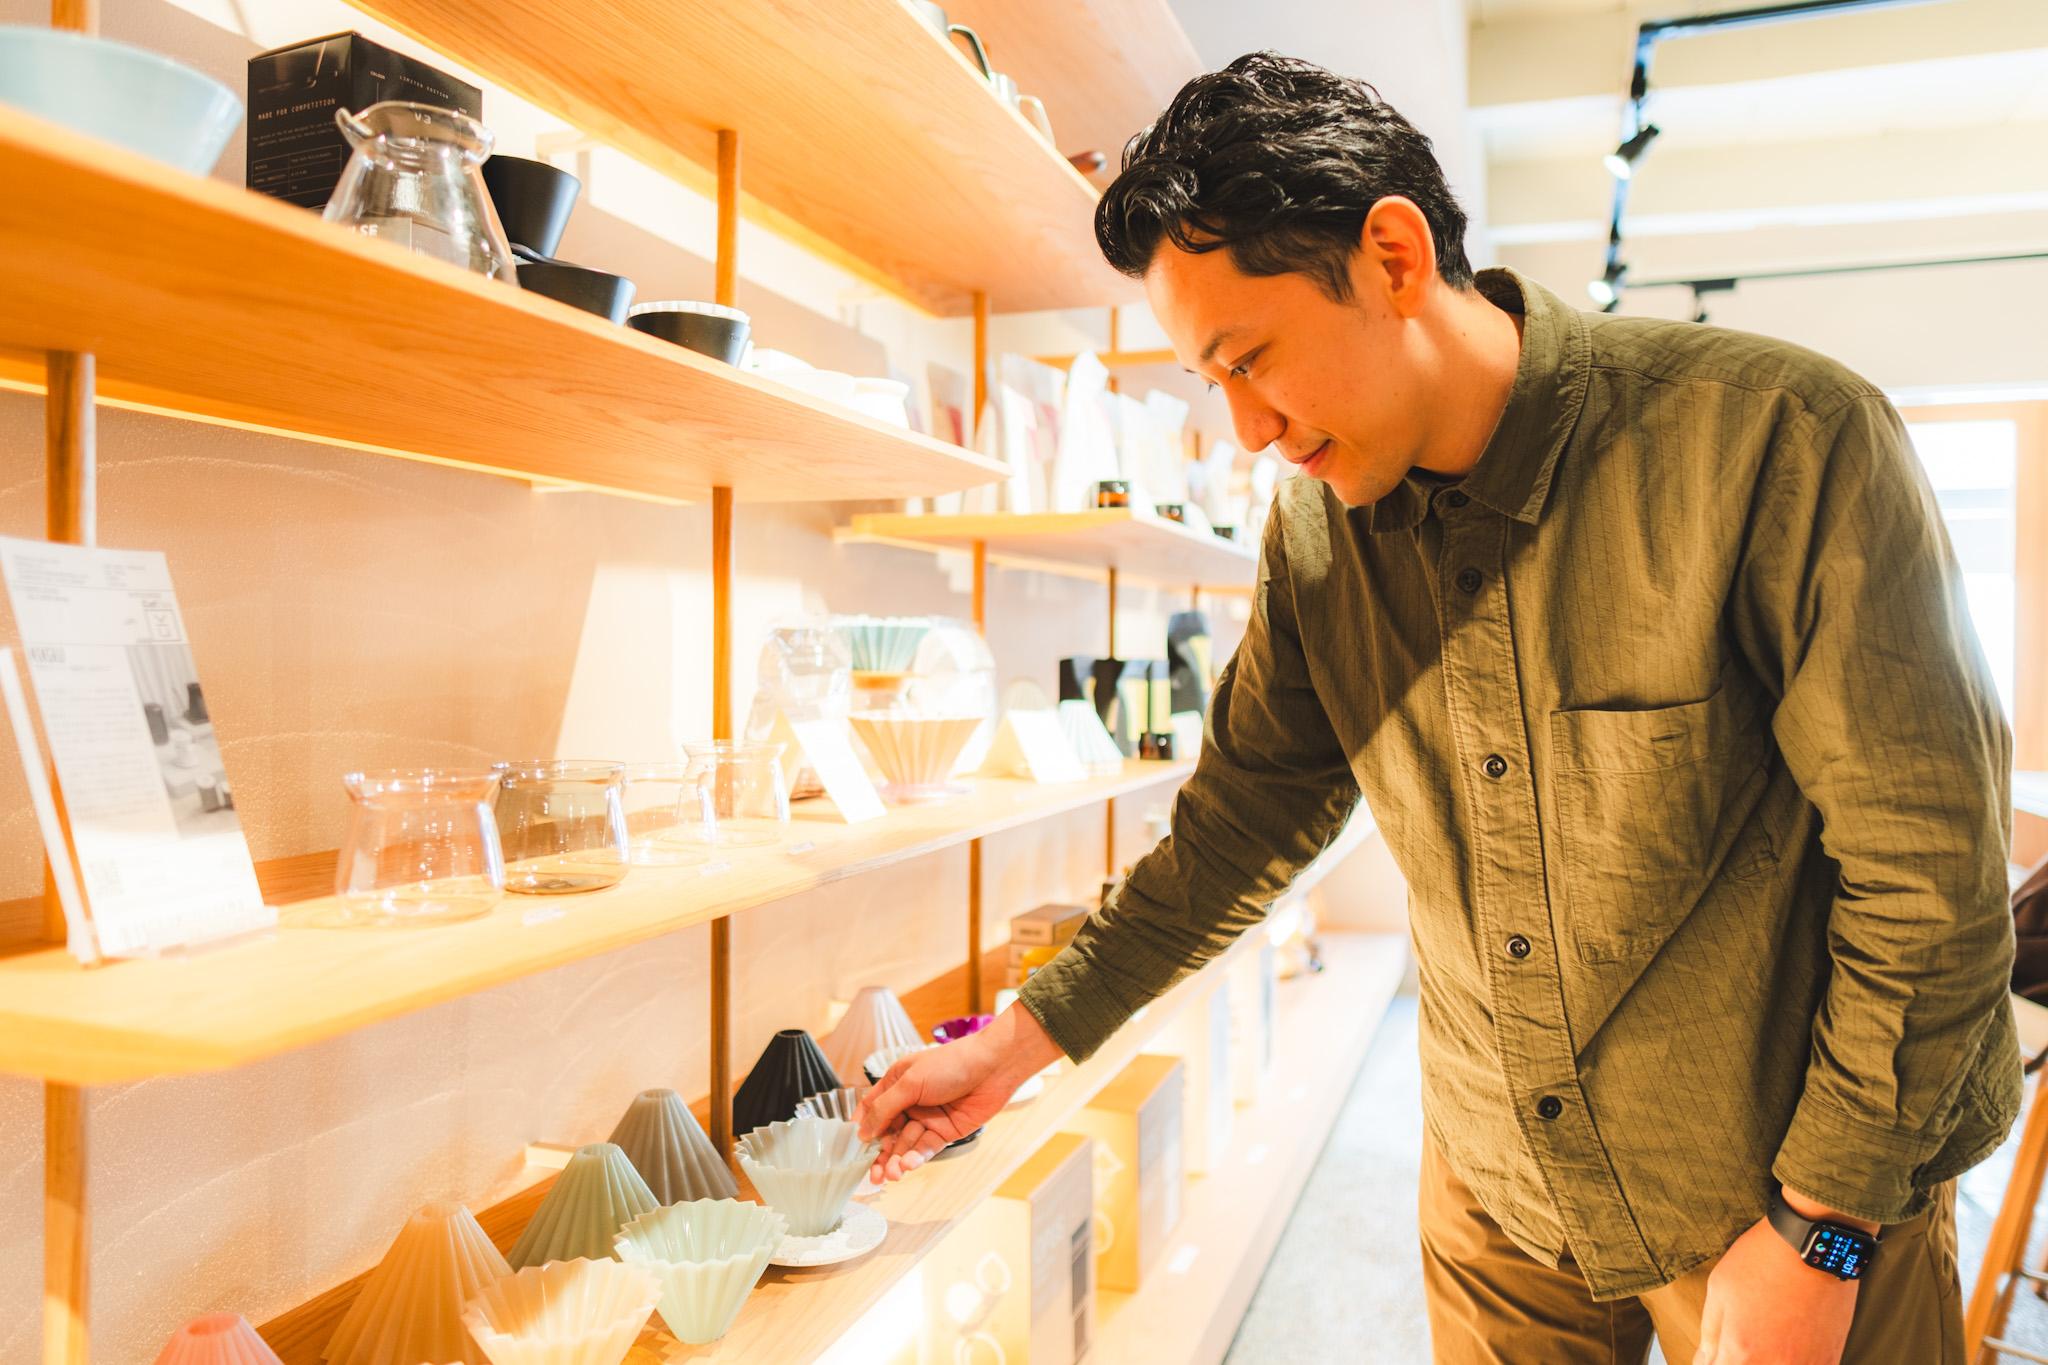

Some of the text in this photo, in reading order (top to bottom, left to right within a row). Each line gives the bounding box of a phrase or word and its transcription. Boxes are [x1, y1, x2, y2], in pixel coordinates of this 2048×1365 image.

[400, 75, 449, 99] LIMITED EDITION
[257, 97, 336, 120] MADE FOR COMPETITION
[1841, 1254, 1859, 1274] 12:01
